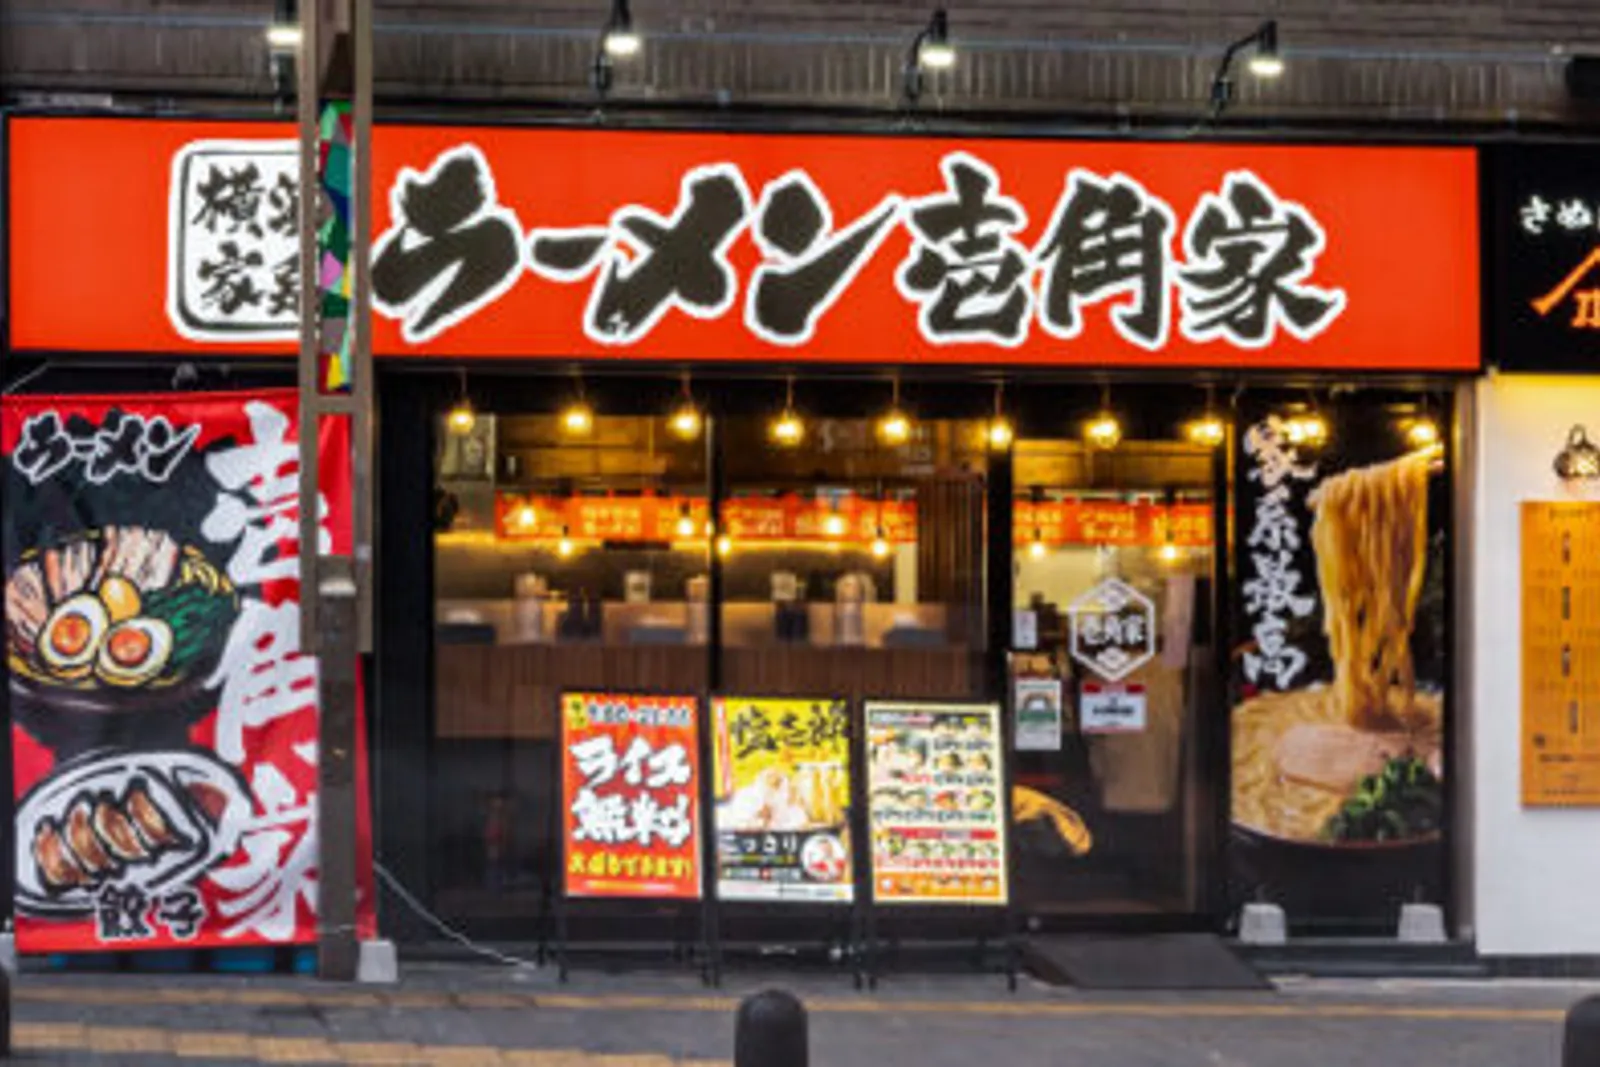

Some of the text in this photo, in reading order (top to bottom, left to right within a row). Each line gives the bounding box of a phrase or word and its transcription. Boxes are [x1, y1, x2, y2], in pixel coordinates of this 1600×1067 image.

[14, 411, 200, 484] ラーメン
[1243, 415, 1317, 689] 家系最高
[569, 734, 692, 788] ライス
[571, 787, 692, 847] 無料
[96, 884, 205, 941] 餃子
